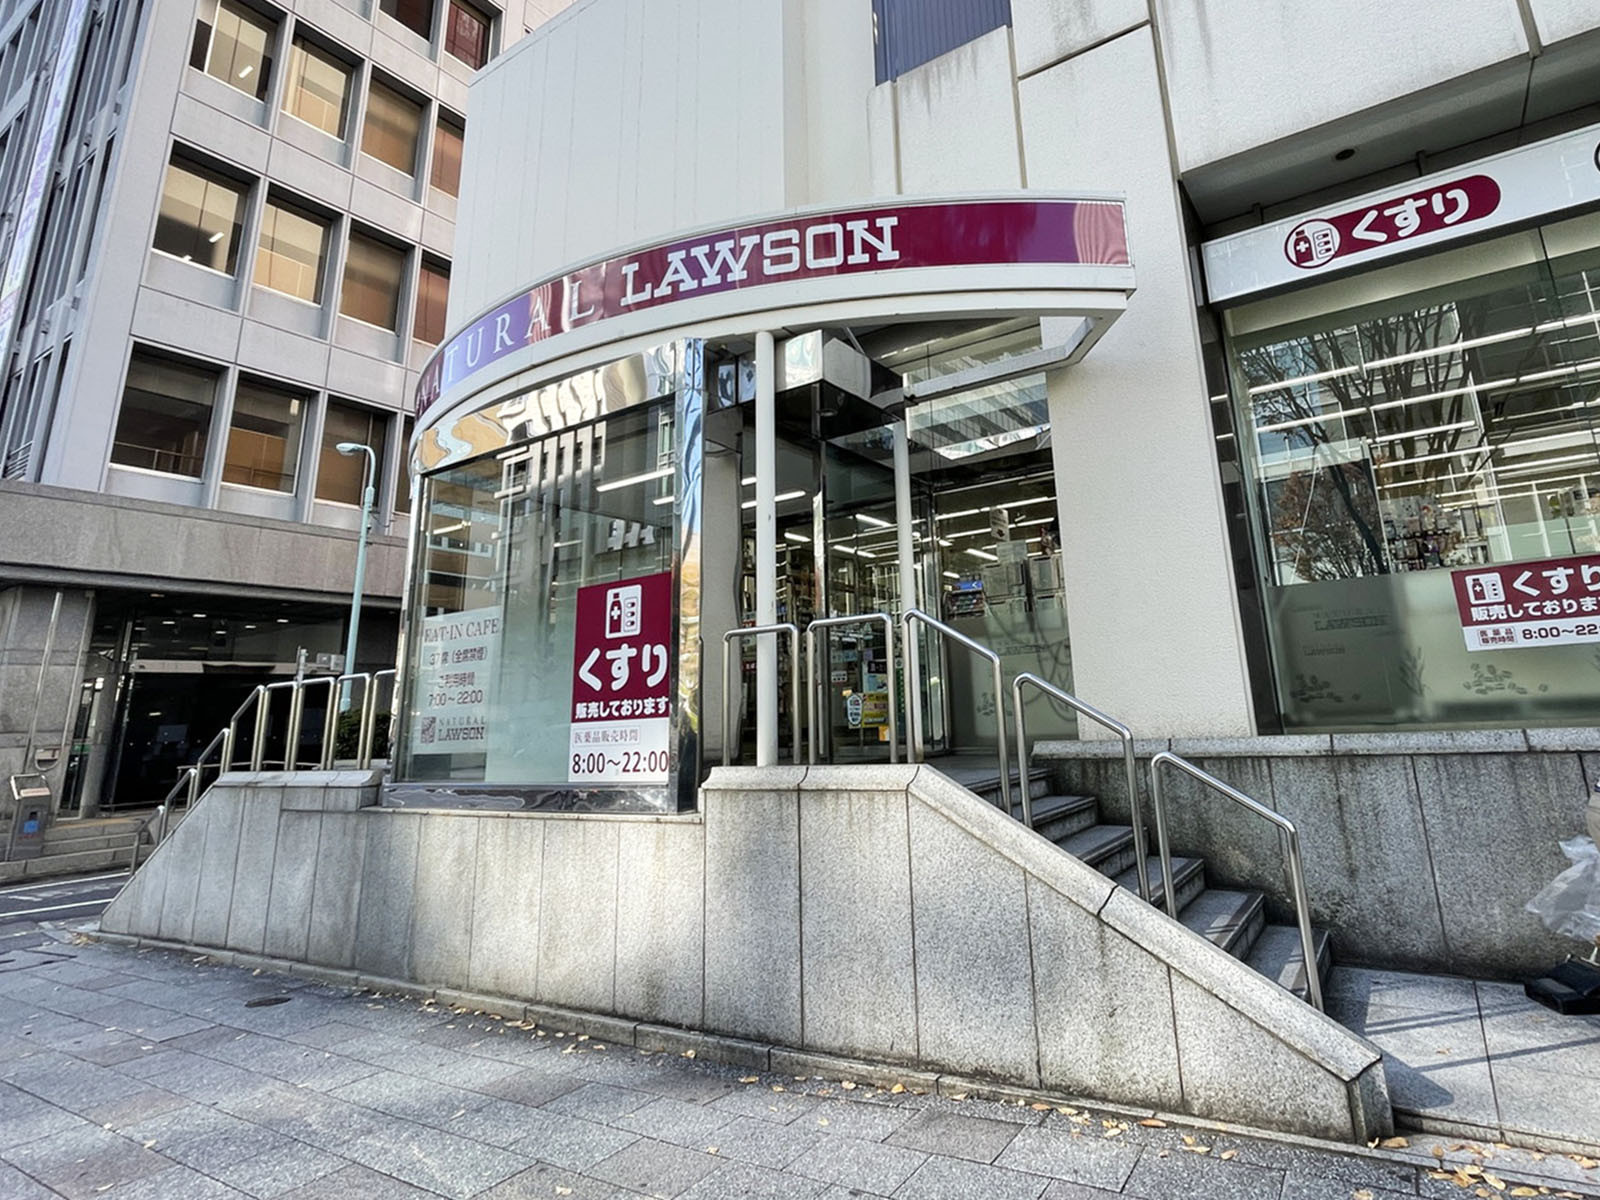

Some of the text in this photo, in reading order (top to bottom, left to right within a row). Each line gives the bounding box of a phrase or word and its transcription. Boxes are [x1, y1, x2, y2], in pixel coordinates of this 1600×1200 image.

[1351, 187, 1469, 243] くすり
[416, 216, 899, 417] NATURAL LAWSON
[1470, 596, 1600, 621] 販売しておりま
[578, 643, 669, 692] くすり
[575, 695, 669, 719] 販売しております
[437, 726, 485, 742] LAWSON
